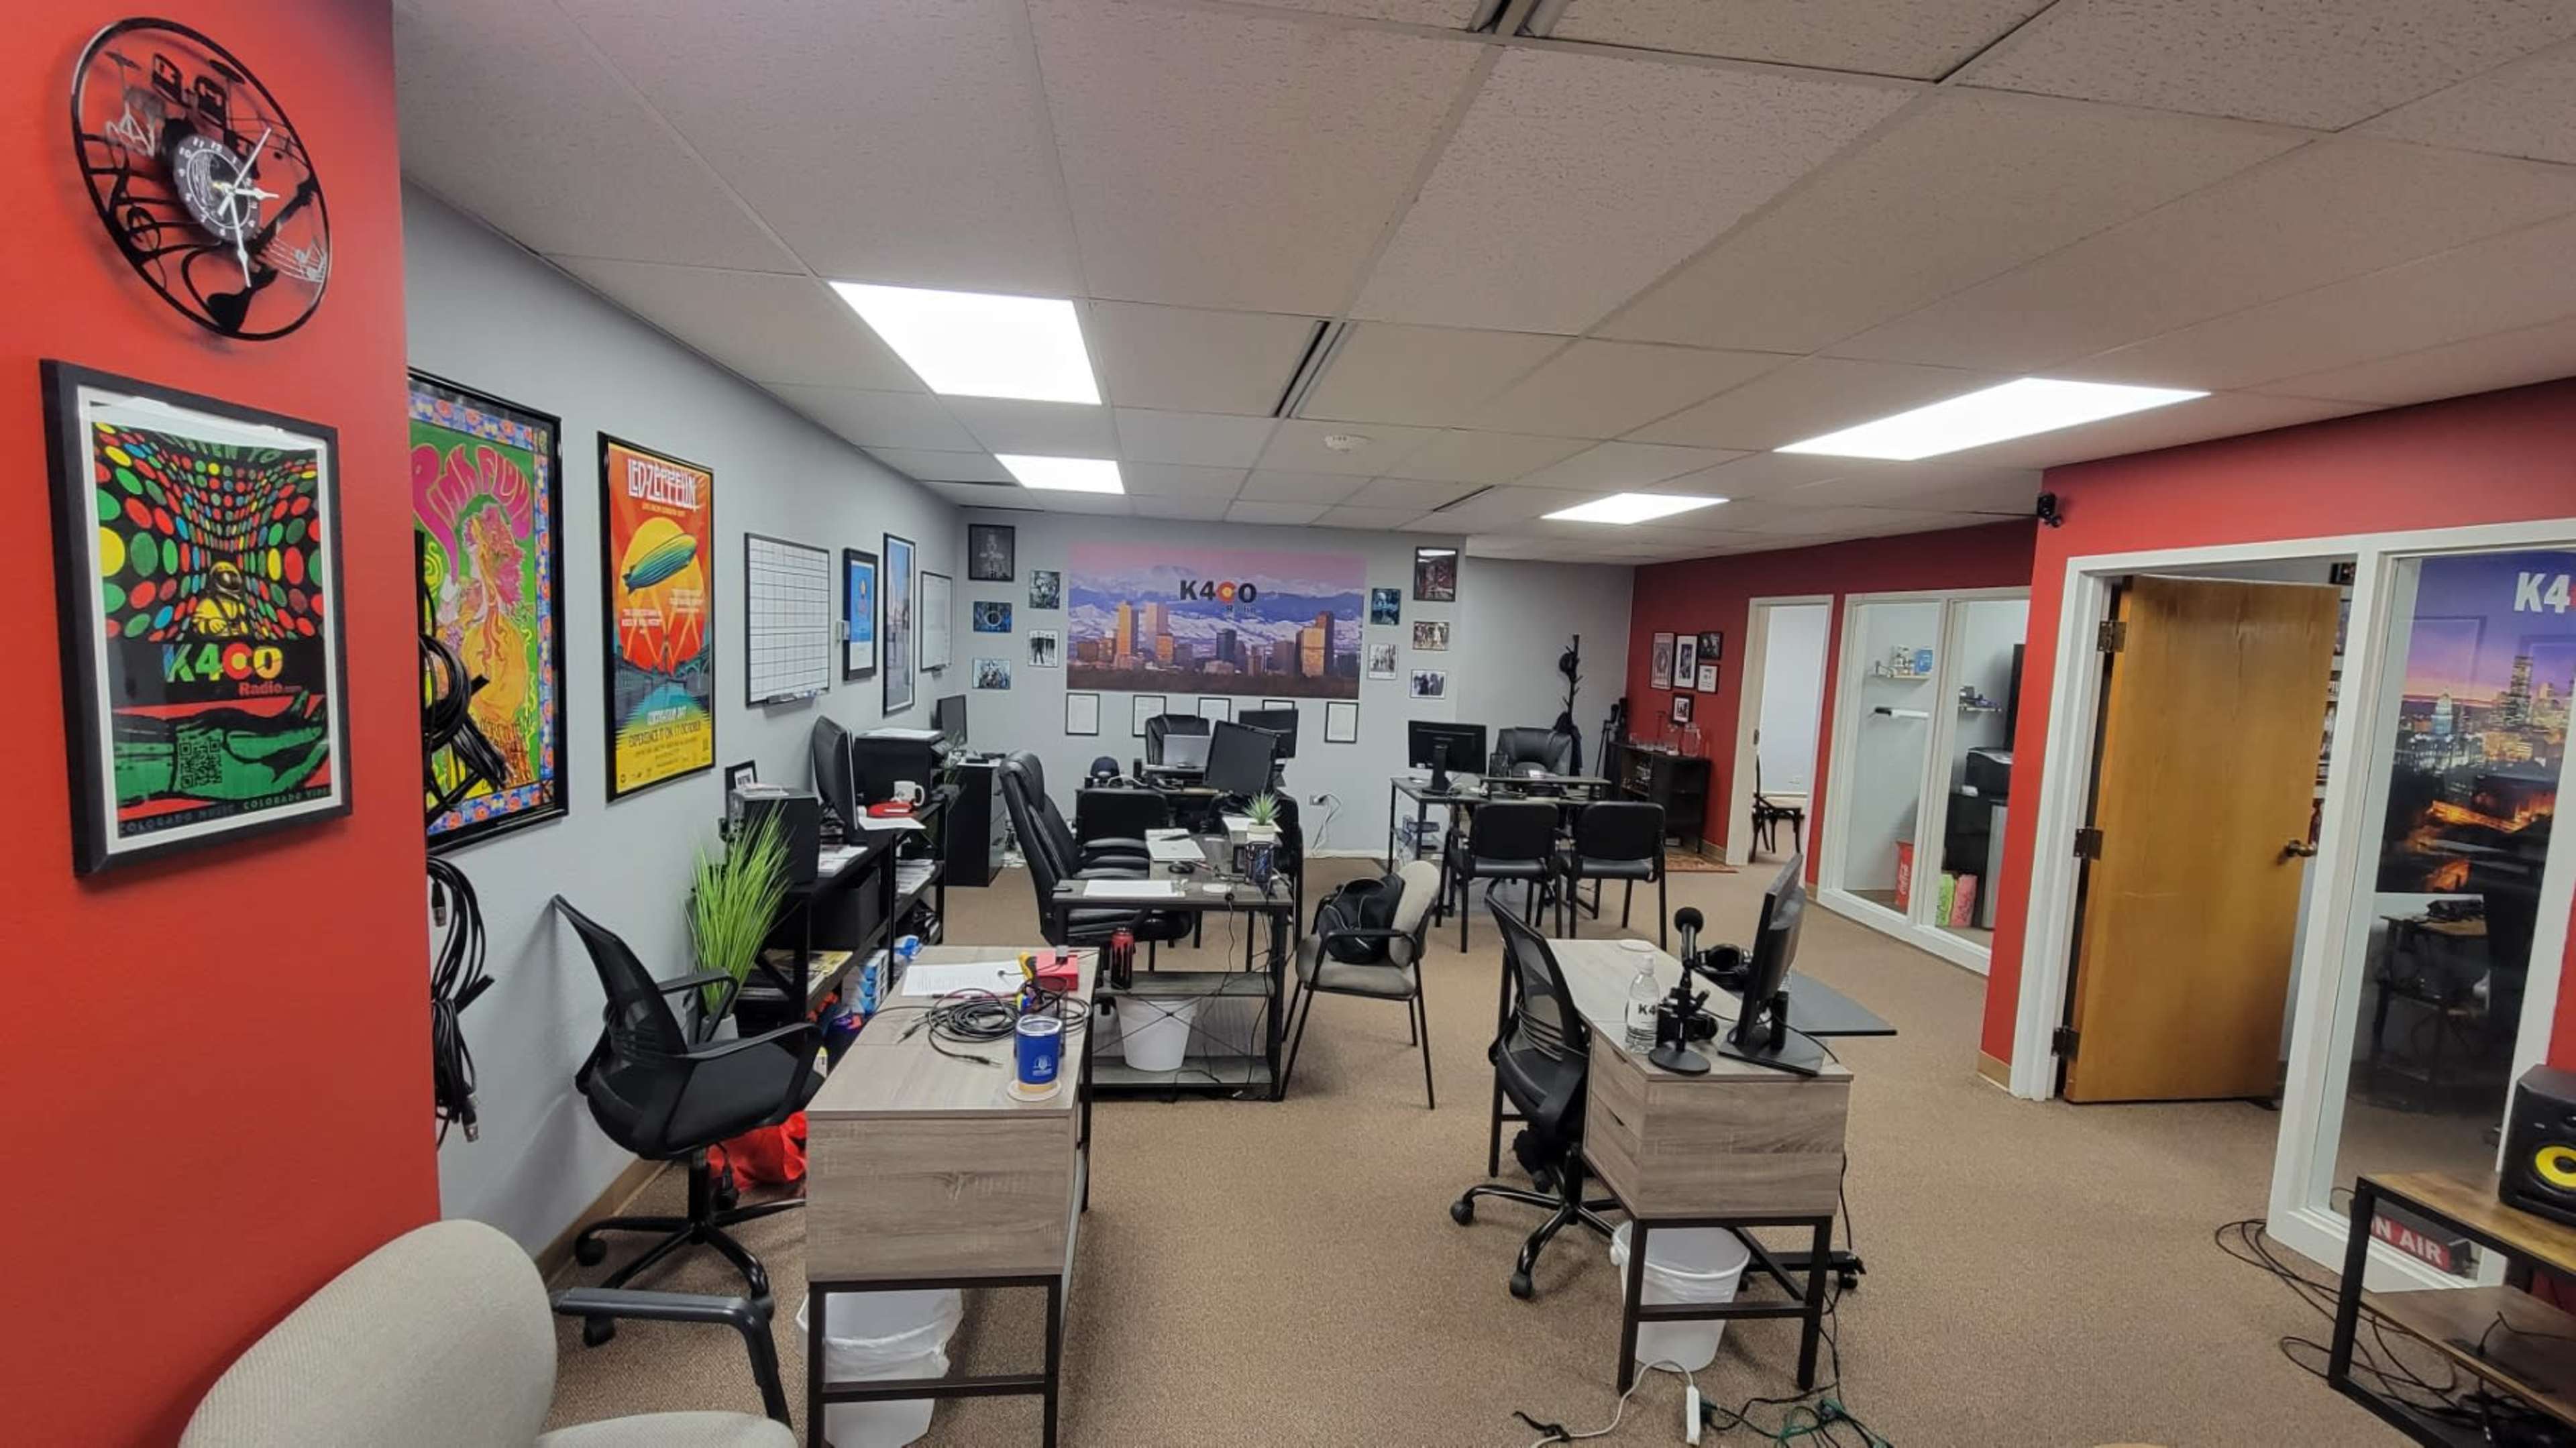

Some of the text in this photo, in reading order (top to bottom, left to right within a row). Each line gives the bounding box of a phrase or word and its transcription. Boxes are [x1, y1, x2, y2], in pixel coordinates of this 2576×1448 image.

[1180, 580, 1256, 604] K4CO
[2514, 571, 2576, 614] K4
[162, 642, 283, 683] K4CO
[2371, 1215, 2443, 1266] N AIR
